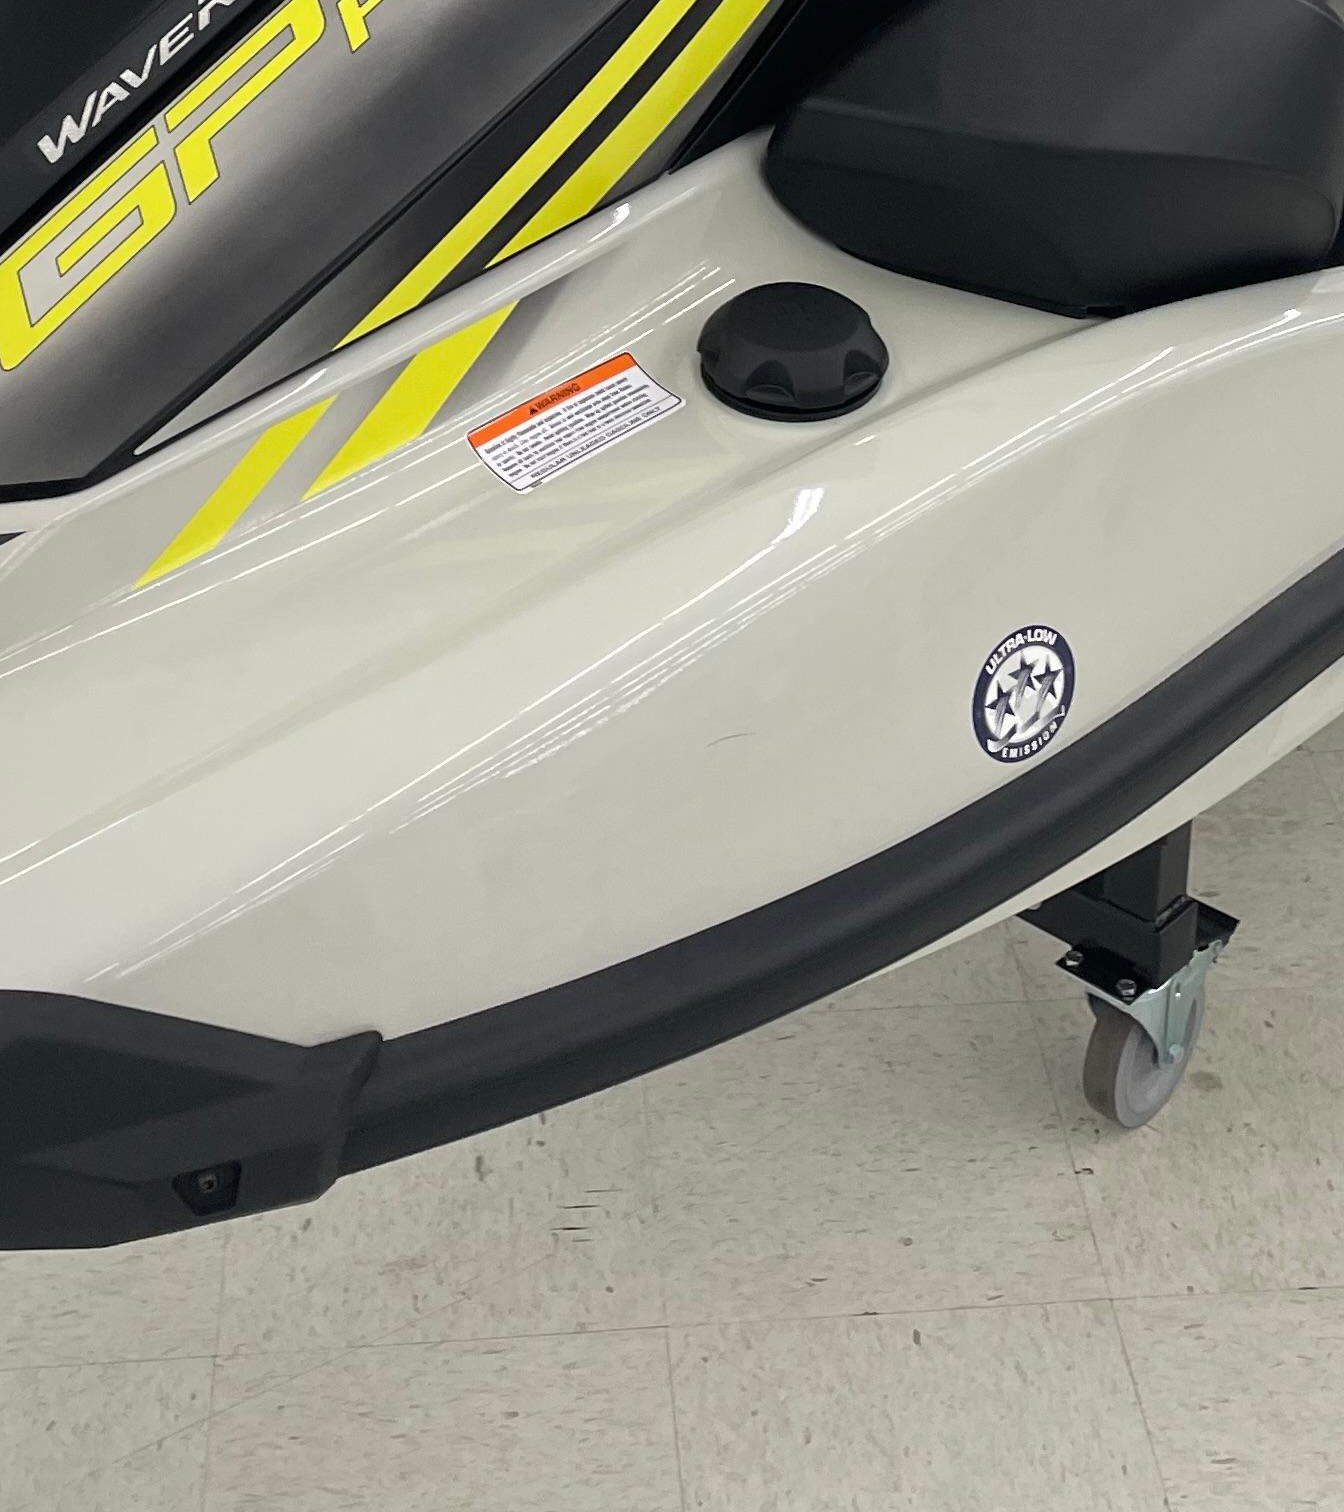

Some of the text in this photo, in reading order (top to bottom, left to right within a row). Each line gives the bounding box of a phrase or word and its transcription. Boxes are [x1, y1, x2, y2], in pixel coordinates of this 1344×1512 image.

[536, 382, 581, 410] WARNING
[985, 628, 1058, 675] ULTRA-LOW
[1001, 721, 1058, 759] EMISSION
